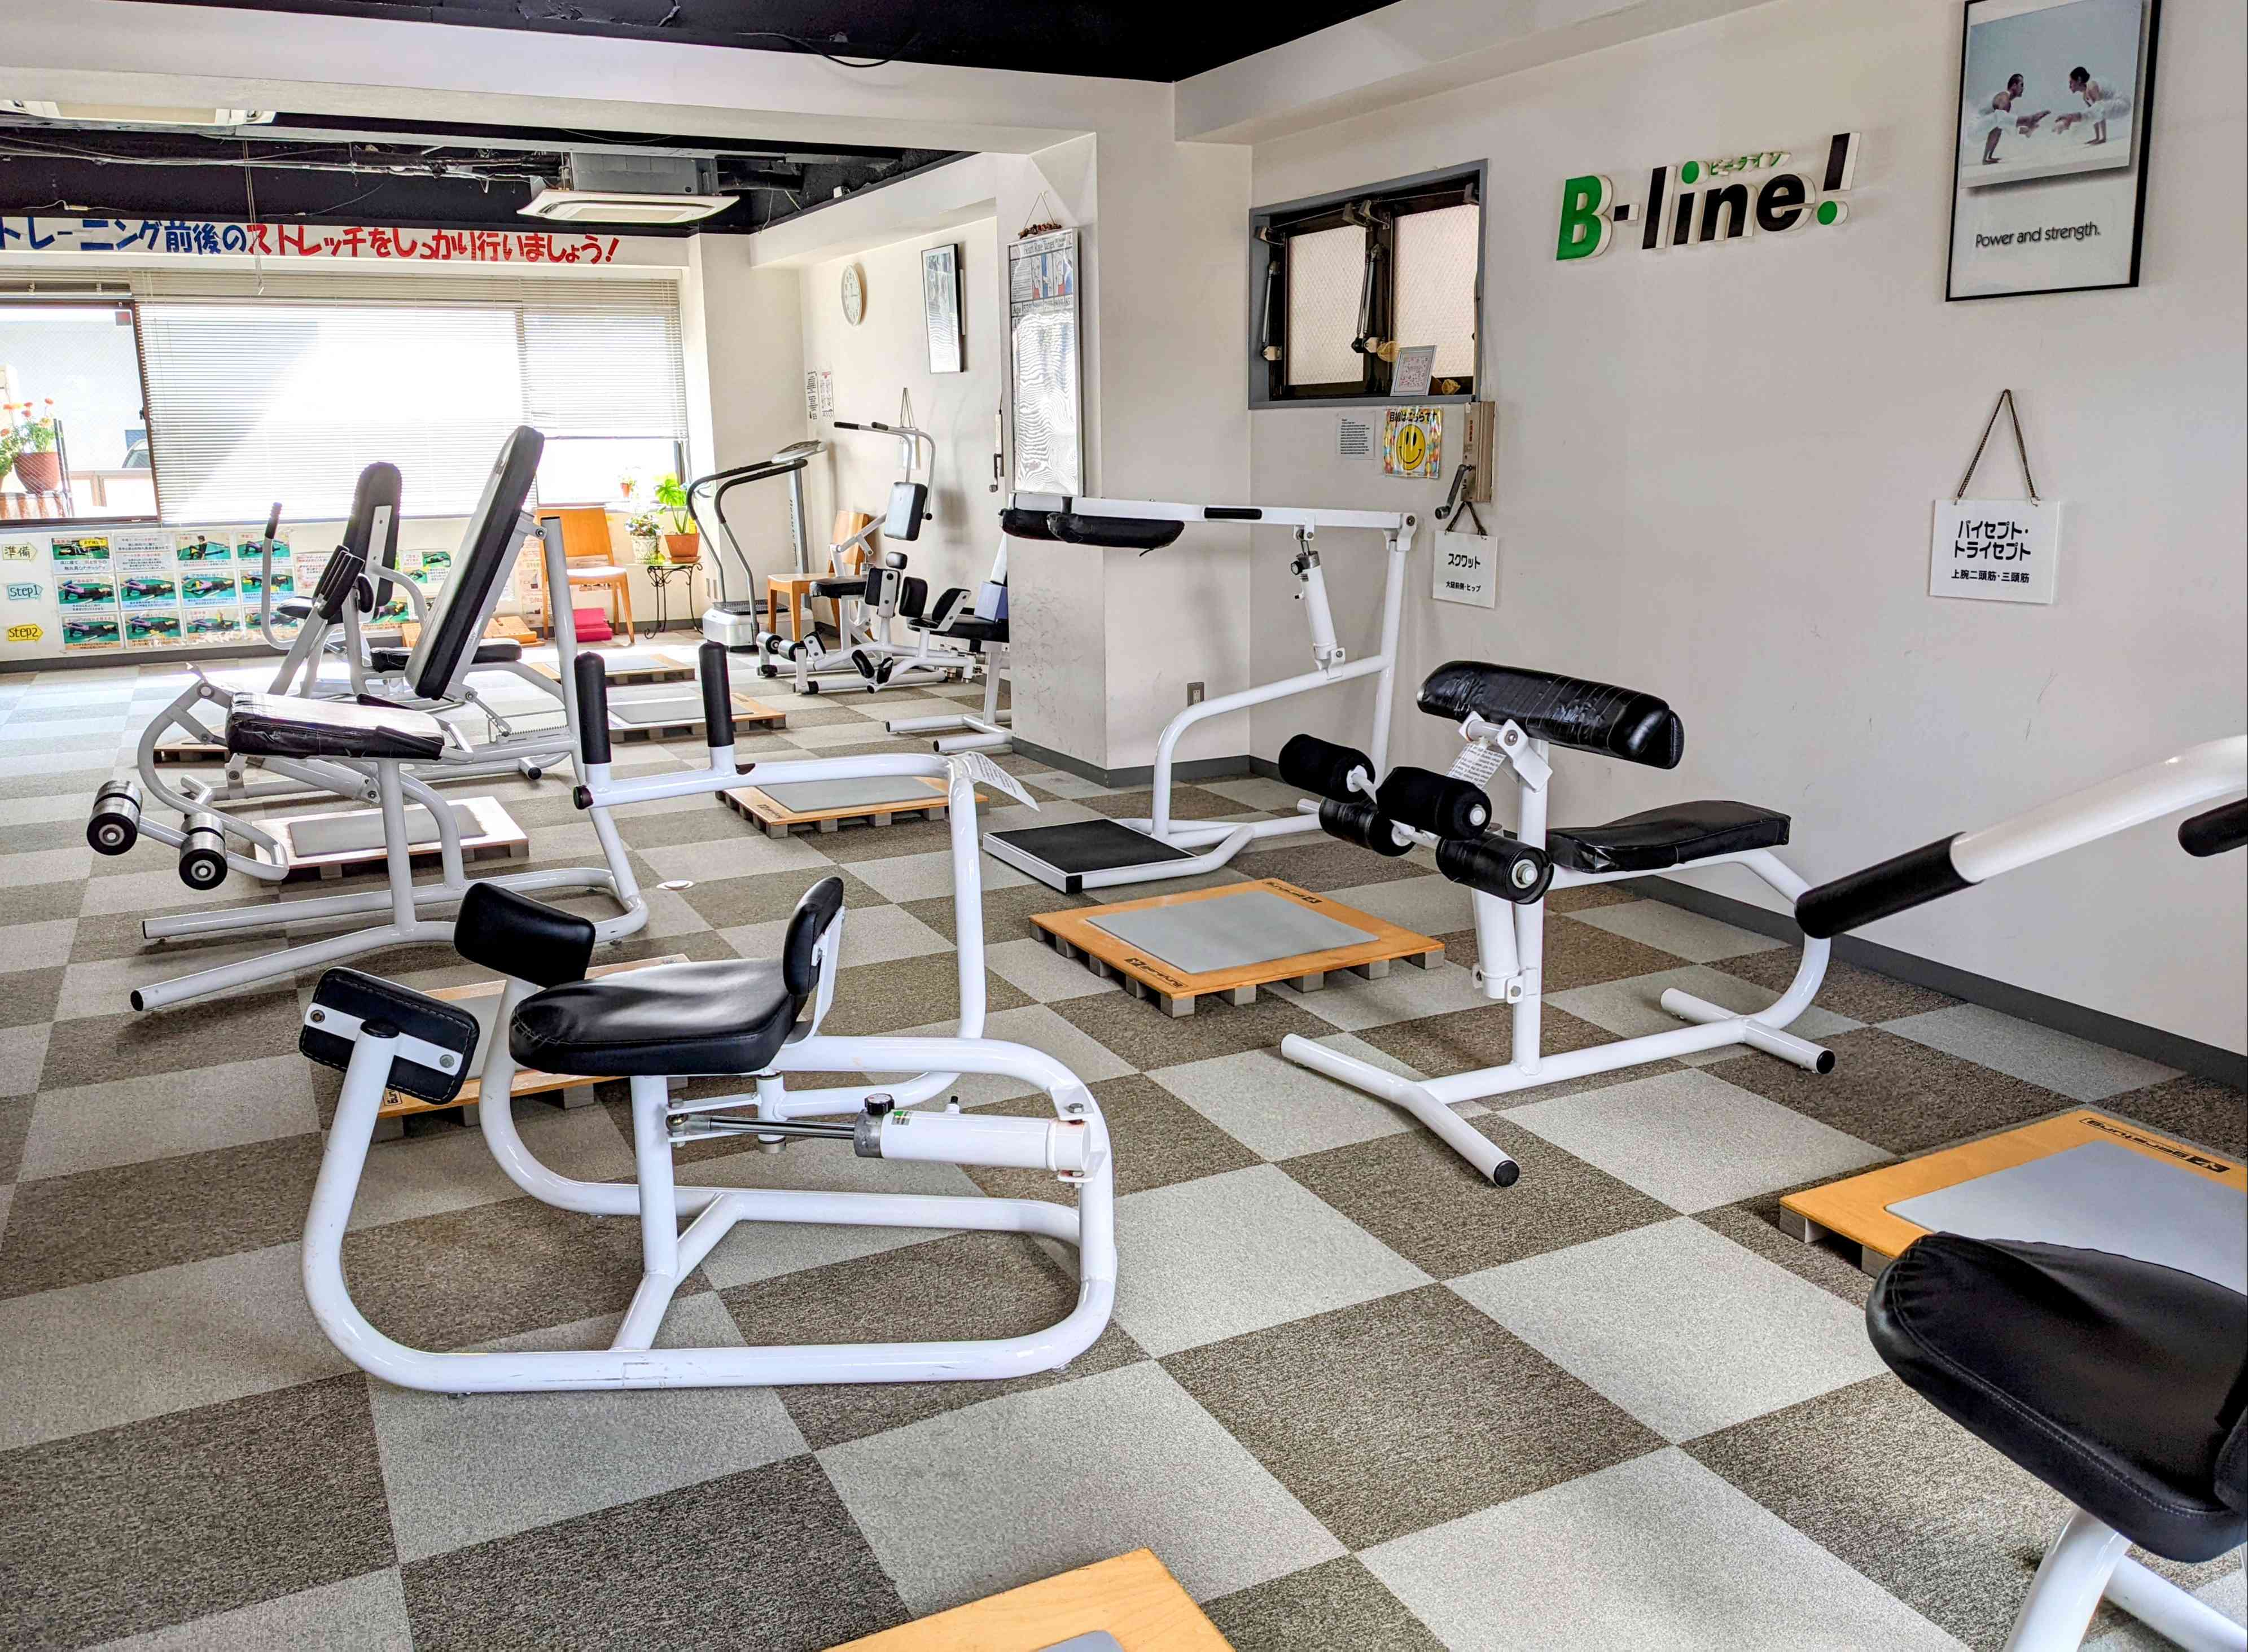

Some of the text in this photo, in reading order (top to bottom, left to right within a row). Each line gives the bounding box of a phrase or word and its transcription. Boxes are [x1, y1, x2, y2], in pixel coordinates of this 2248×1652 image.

[1975, 221, 2101, 247] Power and strength.
[4, 545, 30, 559] 準備
[1955, 540, 2031, 561] トライセプト
[1448, 553, 1481, 569] スクワット
[10, 585, 38, 597] Step1
[8, 627, 39, 640] Step2
